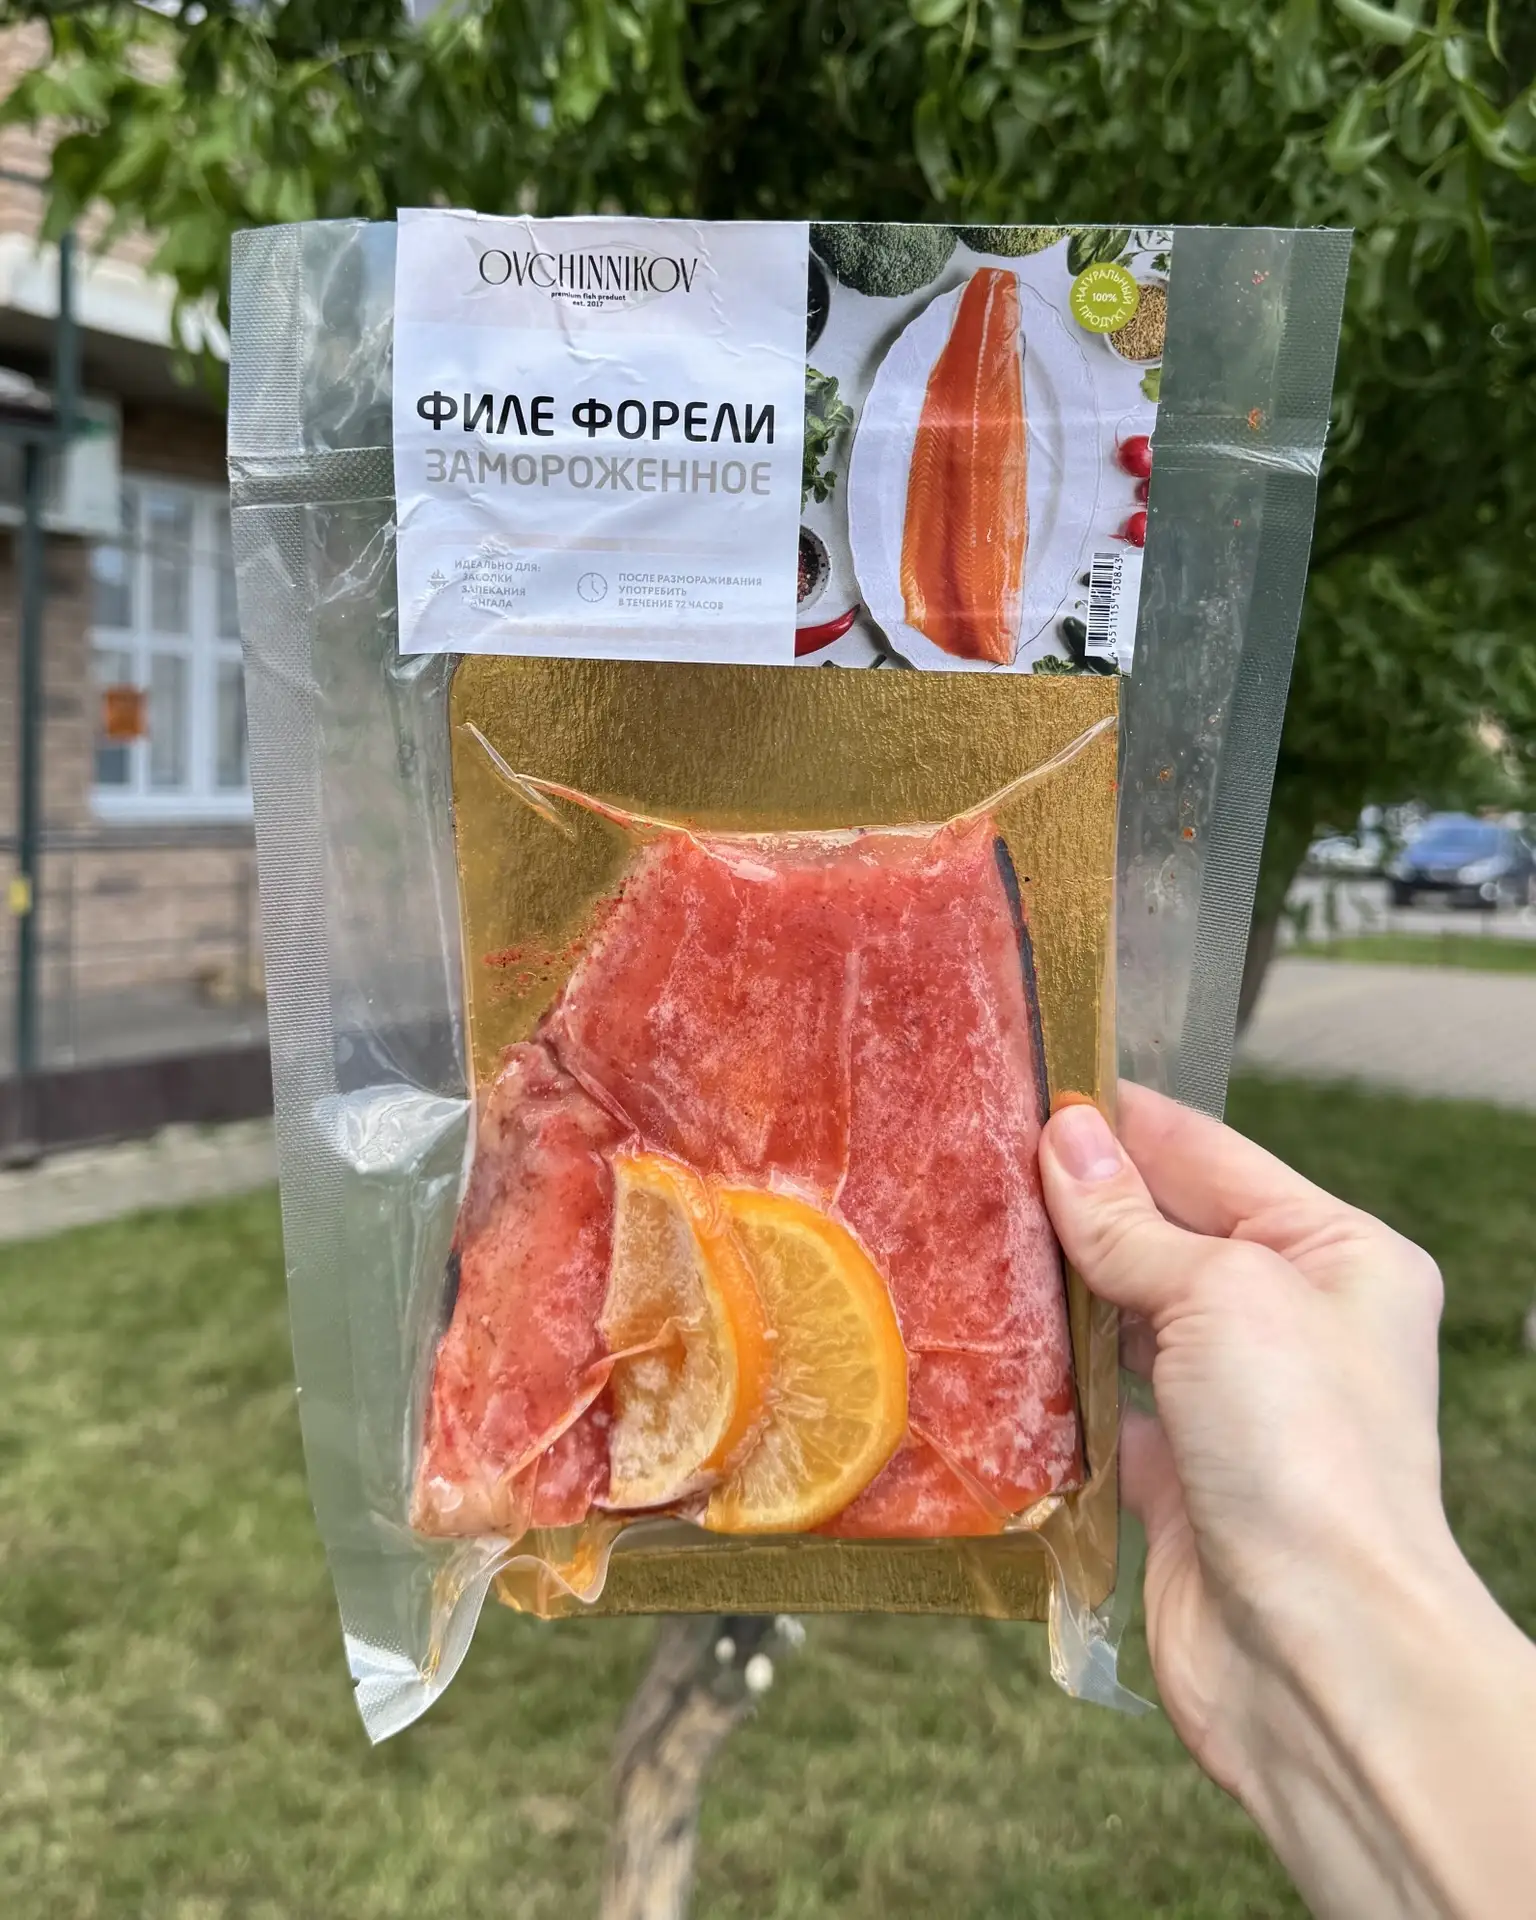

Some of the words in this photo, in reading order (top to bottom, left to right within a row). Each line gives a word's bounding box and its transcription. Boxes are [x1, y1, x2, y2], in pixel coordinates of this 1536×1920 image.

[479, 249, 698, 293] OVCHINNIKOV
[1076, 269, 1134, 305] НАТУРАЛЬНЫЙ
[1092, 293, 1117, 302] 100%
[1079, 305, 1126, 328] ПРОДУКТ
[416, 391, 554, 437] ФИЛЕ
[572, 398, 775, 444] ФОРЕЛИ
[425, 449, 772, 496] ЗАМОРОЖЕННОЕ
[454, 560, 513, 570] ИДЕАЛЬНО
[515, 562, 541, 572] ДЛЯ:
[463, 573, 512, 582] ЗАСОЛКИ
[619, 573, 655, 583] ПОСЛЕ
[658, 574, 762, 586] РАЗМОРАЖИВАНИЯ
[461, 585, 526, 596] ЗАПЕКАНИЯ
[618, 585, 687, 596] УПОТРЕБИТЬ
[626, 599, 673, 608] ТЕЧЕНИЕ
[689, 601, 724, 610] ЧАСОВ
